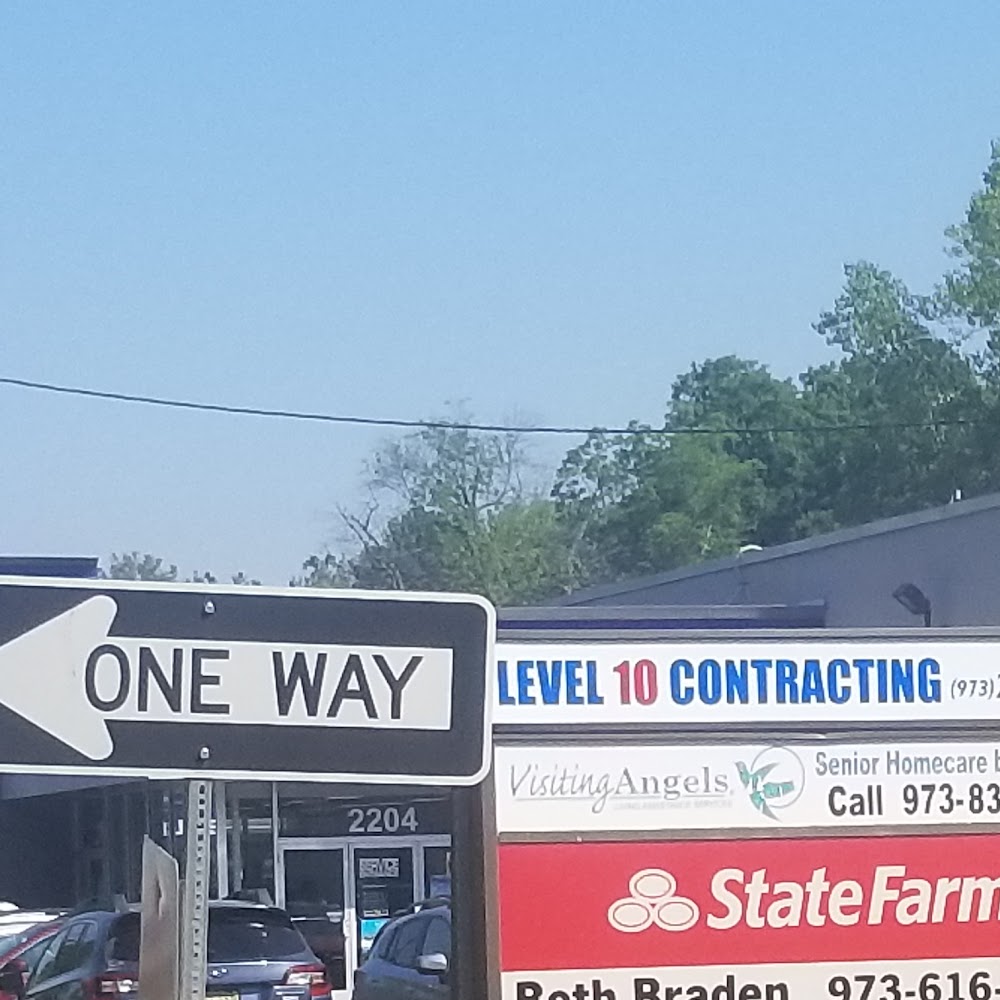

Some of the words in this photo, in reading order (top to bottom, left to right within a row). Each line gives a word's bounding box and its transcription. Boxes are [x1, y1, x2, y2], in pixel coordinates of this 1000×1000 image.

[85, 644, 230, 714] ONE
[272, 651, 423, 720] WAY
[497, 660, 603, 706] LEVEL
[613, 659, 657, 706] 10
[670, 658, 942, 704] CONTRACTING
[815, 751, 880, 777] Senior
[886, 750, 988, 775] Homecare
[828, 785, 883, 816] Call
[347, 806, 419, 833] 2204
